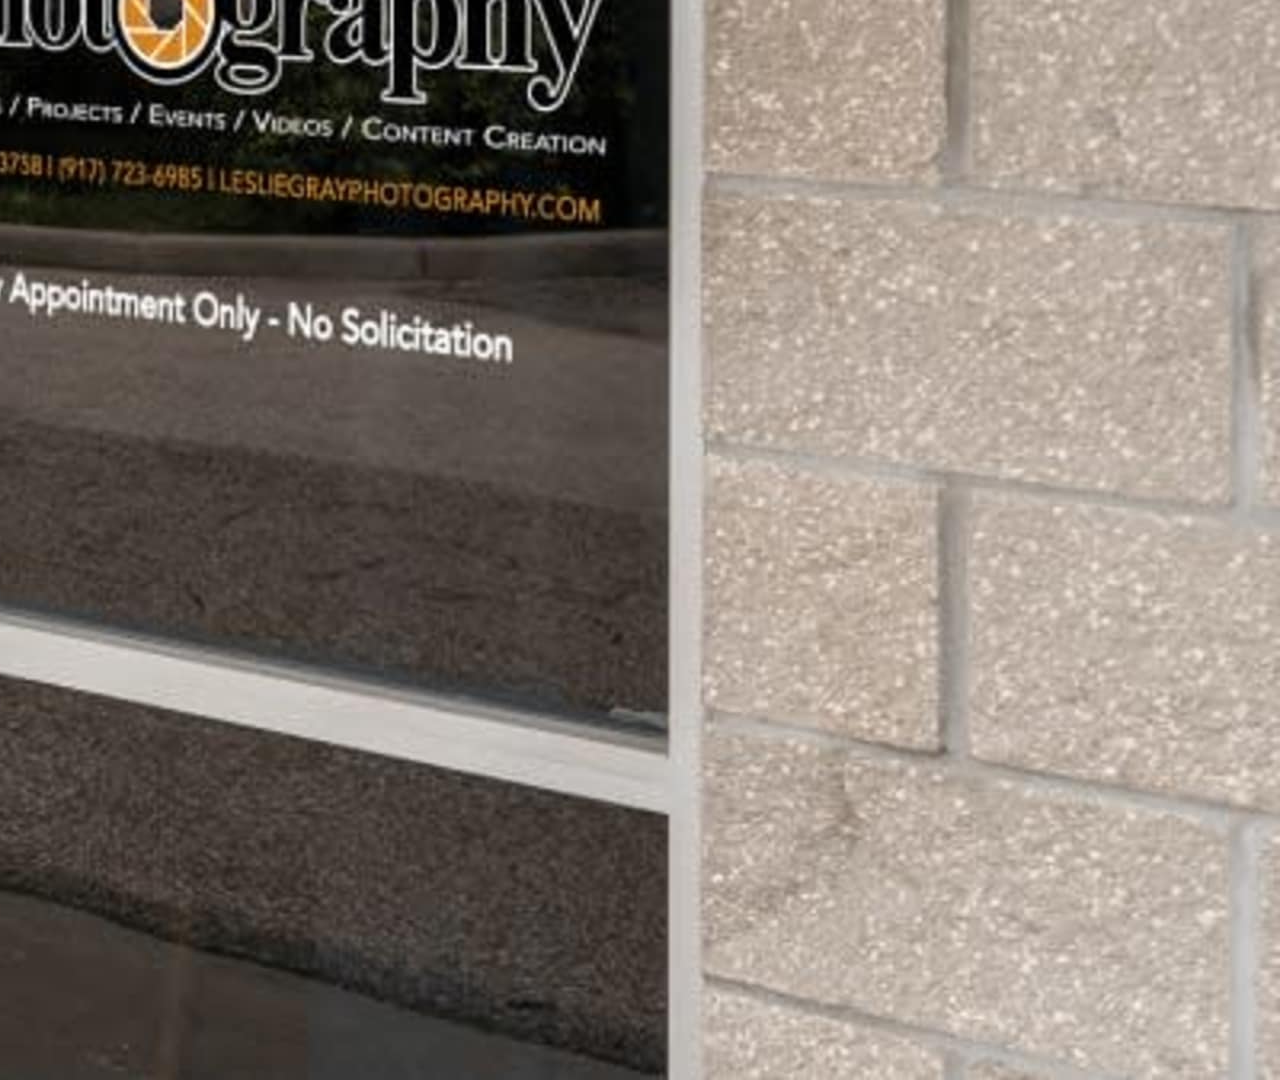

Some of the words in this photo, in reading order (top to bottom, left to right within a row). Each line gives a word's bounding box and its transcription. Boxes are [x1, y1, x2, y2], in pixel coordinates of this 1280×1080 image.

[57, 157, 105, 185] (917)
[112, 160, 202, 191] 723-6985
[220, 172, 602, 223] LESLIEGRAYPHOTOGRAPHY.COM
[8, 272, 186, 325] Appointment
[193, 291, 261, 341] Only
[287, 302, 333, 340] No
[340, 308, 515, 363] Solicitation
